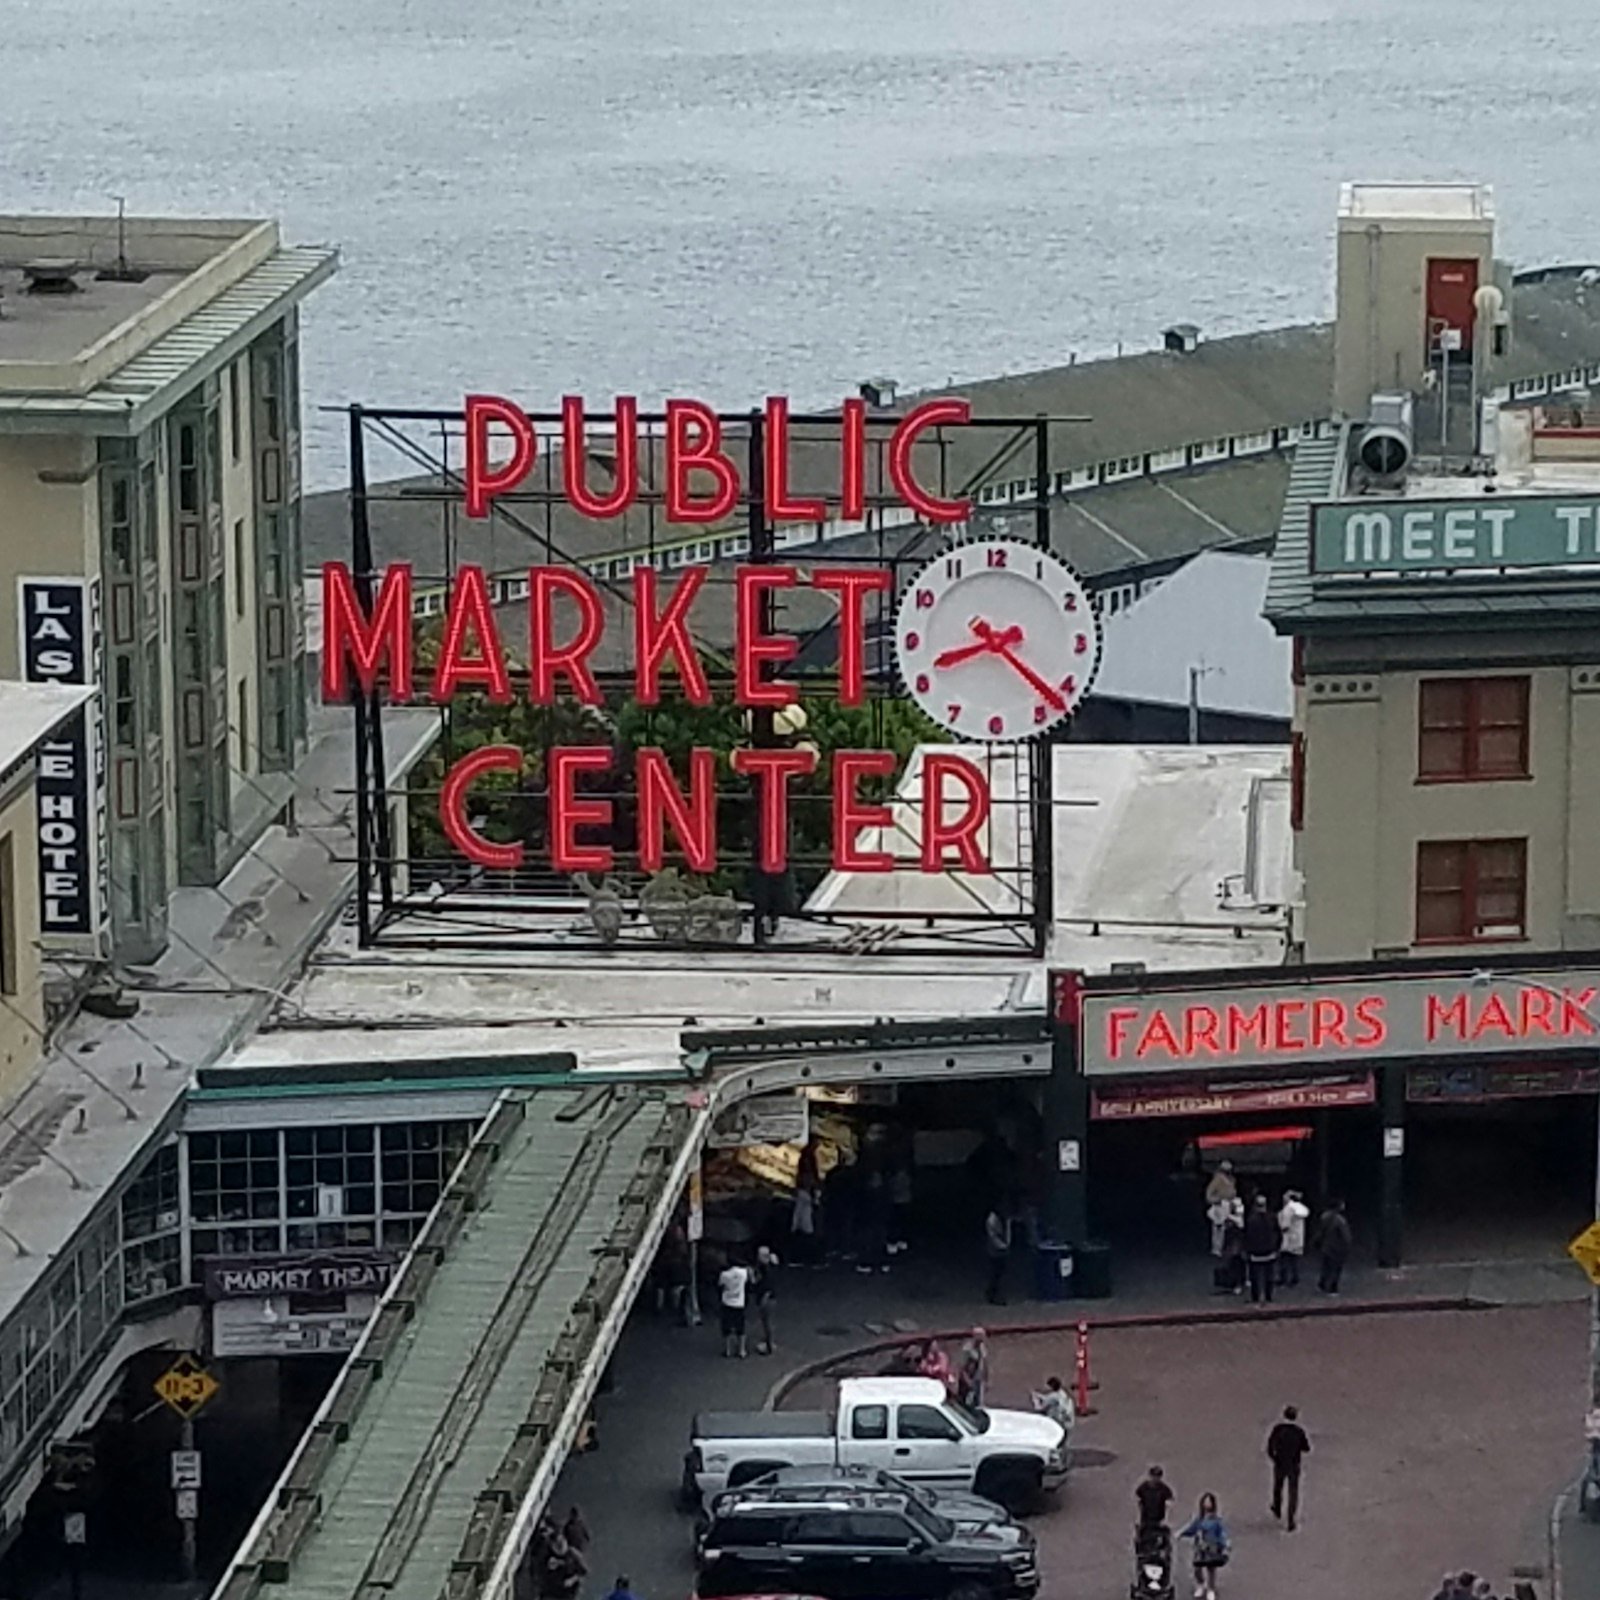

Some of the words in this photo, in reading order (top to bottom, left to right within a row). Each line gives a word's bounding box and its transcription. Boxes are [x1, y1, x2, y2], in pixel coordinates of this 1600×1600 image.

[465, 394, 972, 523] PUBLIC
[1344, 508, 1516, 562] MEET
[1555, 506, 1600, 554] T
[946, 559, 962, 579] 11
[986, 549, 1007, 568] 12
[1035, 560, 1043, 580] 1
[916, 589, 935, 609] 10
[1063, 593, 1077, 612] 2
[320, 560, 893, 708] MARKET
[1073, 633, 1088, 655] 3
[1059, 674, 1076, 695] 4
[947, 704, 962, 724] 7
[1034, 705, 1047, 725] 5
[440, 745, 994, 875] CENTER
[40, 795, 78, 922] HOTEL
[1107, 997, 1386, 1059] FARMERS
[1426, 986, 1599, 1043] MARK
[223, 1268, 312, 1291] MARKET
